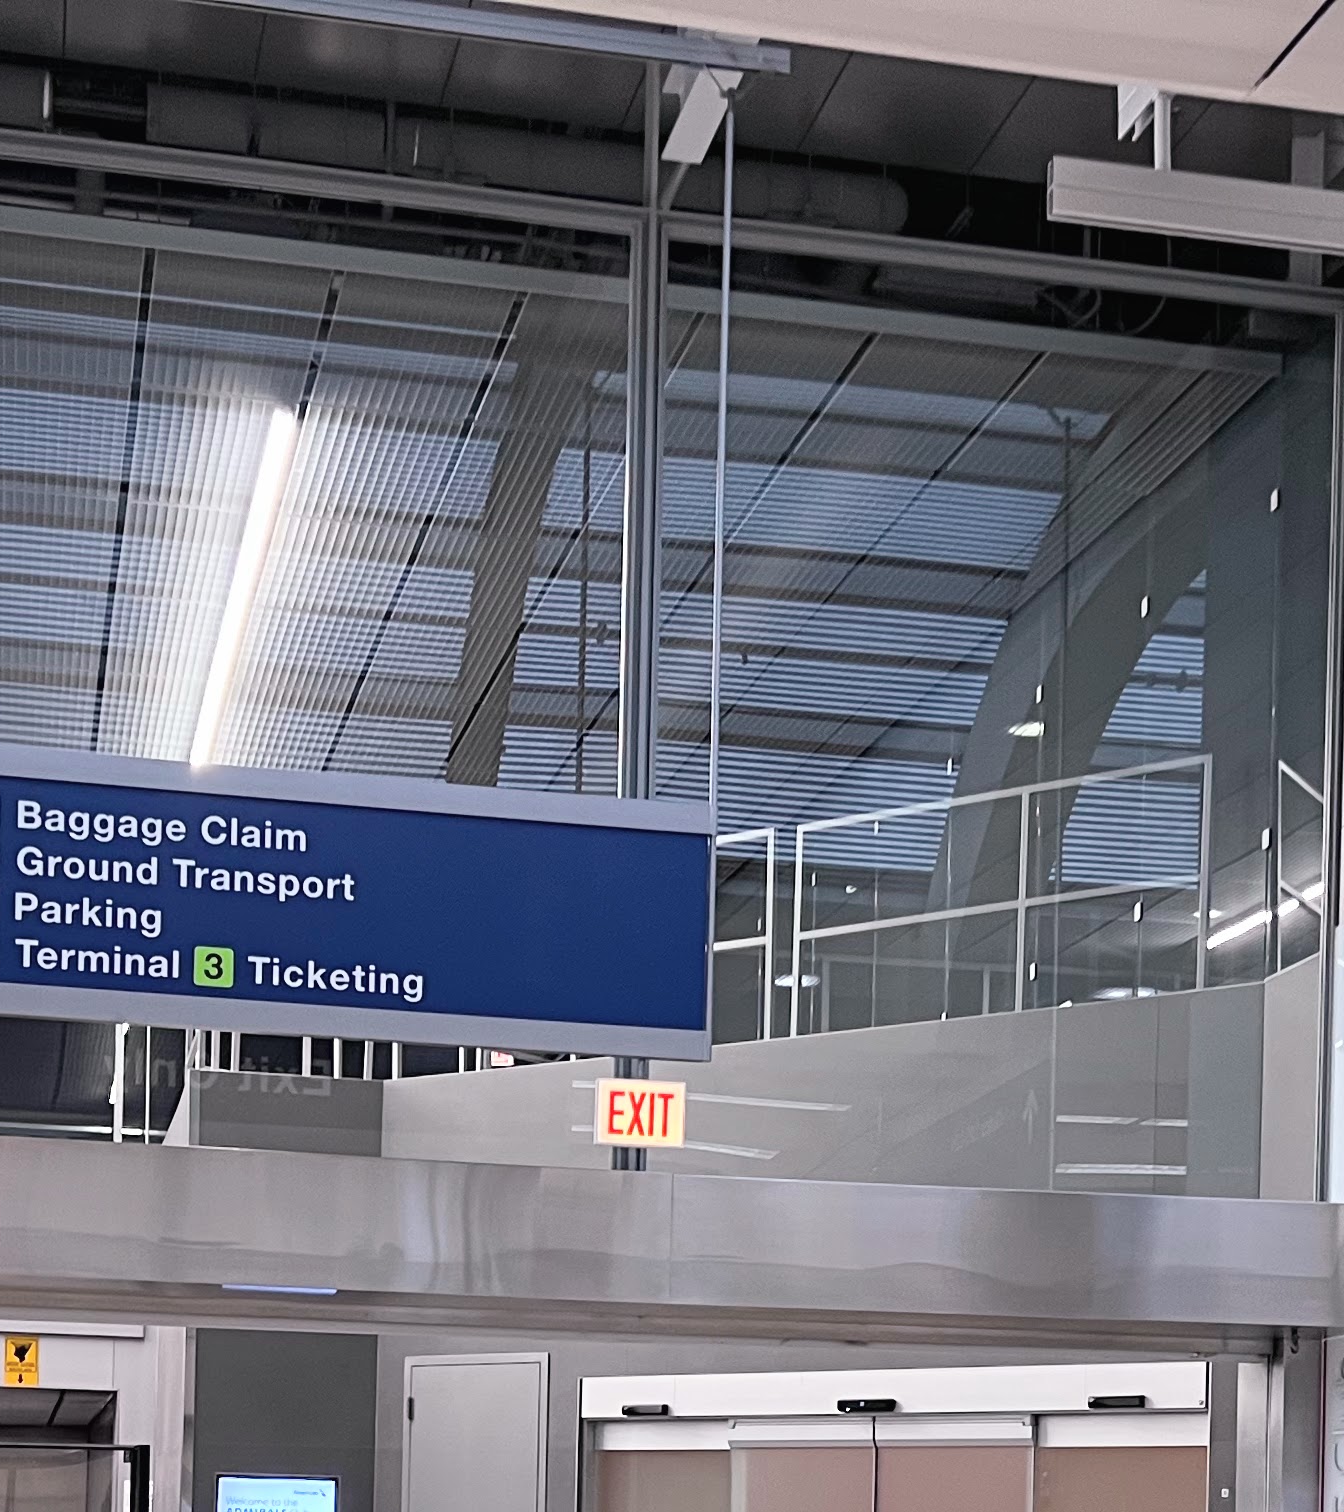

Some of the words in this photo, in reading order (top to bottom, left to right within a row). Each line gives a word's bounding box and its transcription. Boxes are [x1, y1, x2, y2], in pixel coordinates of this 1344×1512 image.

[17, 799, 187, 846] Baggage
[201, 815, 307, 852] Claim
[16, 846, 158, 885] Ground
[172, 858, 355, 902] Transport
[14, 892, 162, 938] Parking
[14, 938, 180, 979] Terminal
[203, 952, 224, 980] 3
[247, 955, 424, 1003] Ticketing
[608, 1090, 674, 1138] EXIT
